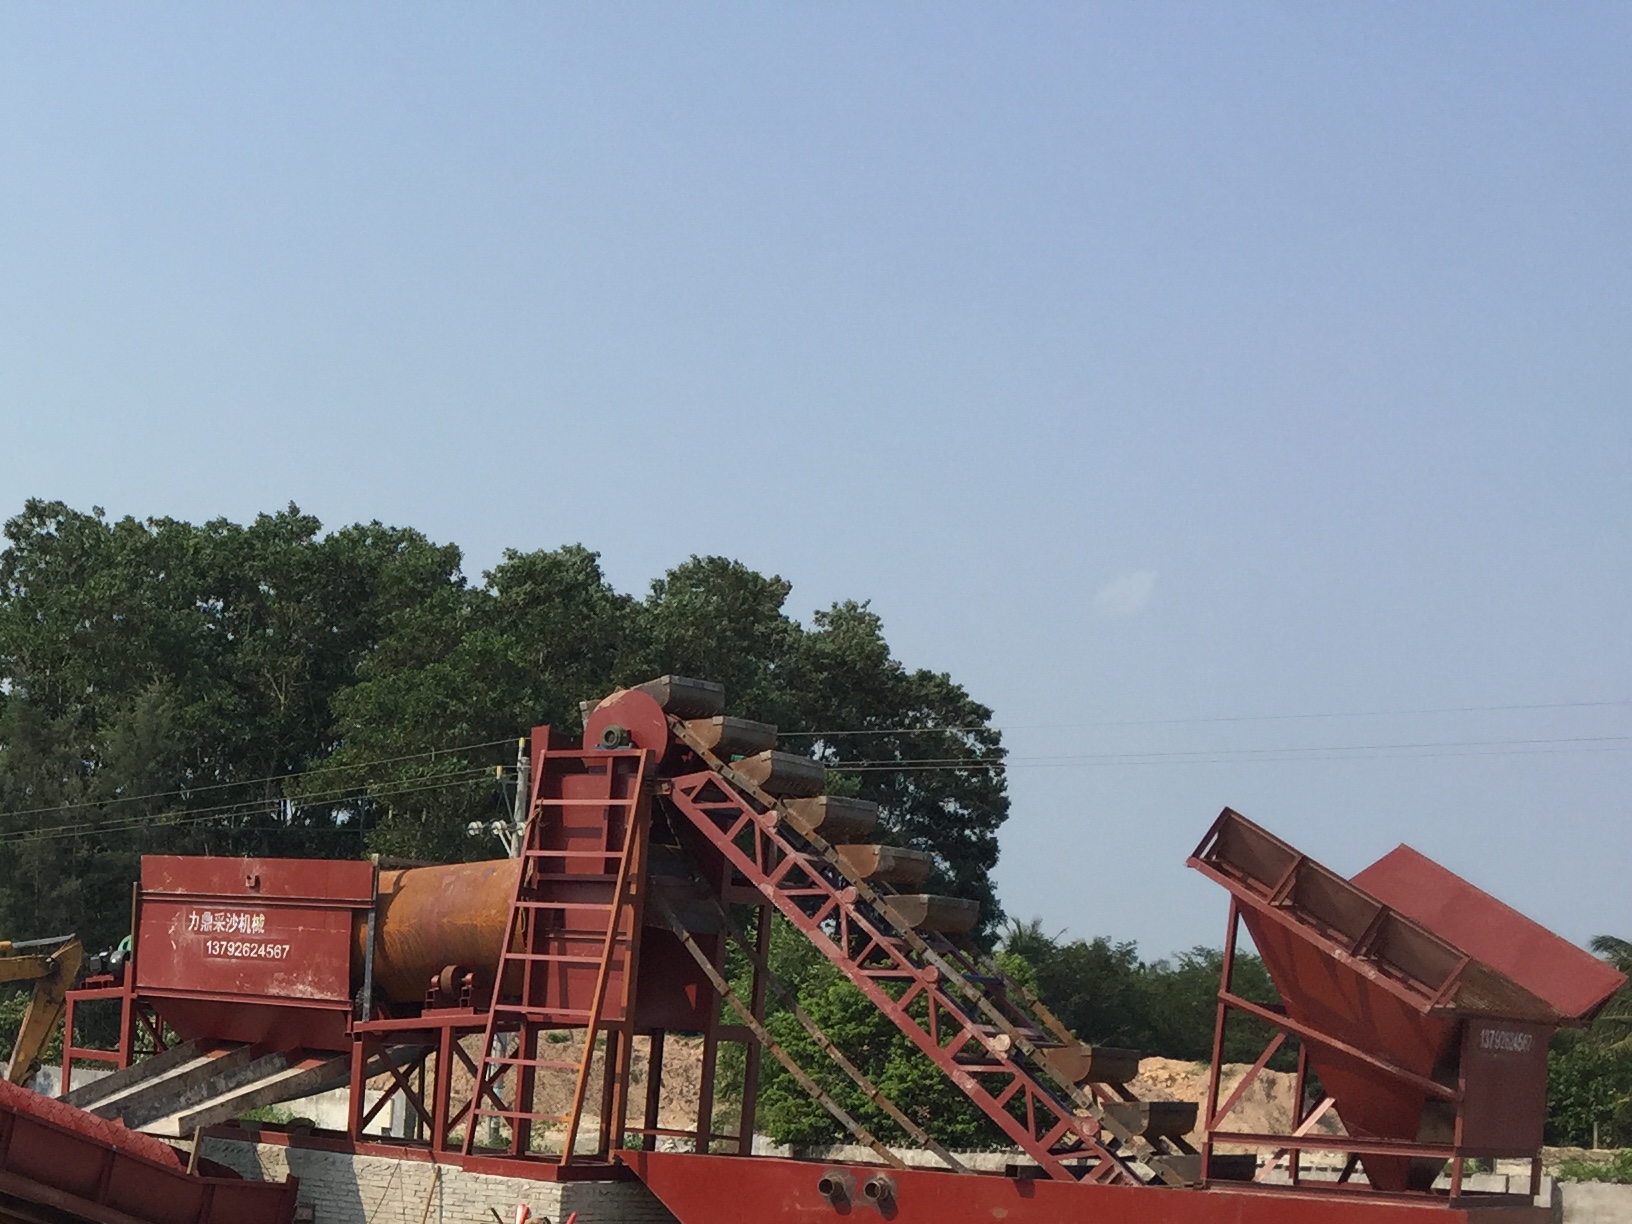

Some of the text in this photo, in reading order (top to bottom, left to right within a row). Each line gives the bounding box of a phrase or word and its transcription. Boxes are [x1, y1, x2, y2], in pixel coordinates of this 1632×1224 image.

[188, 910, 265, 934] 力鼎采沙机械
[206, 940, 290, 959] 13792624567
